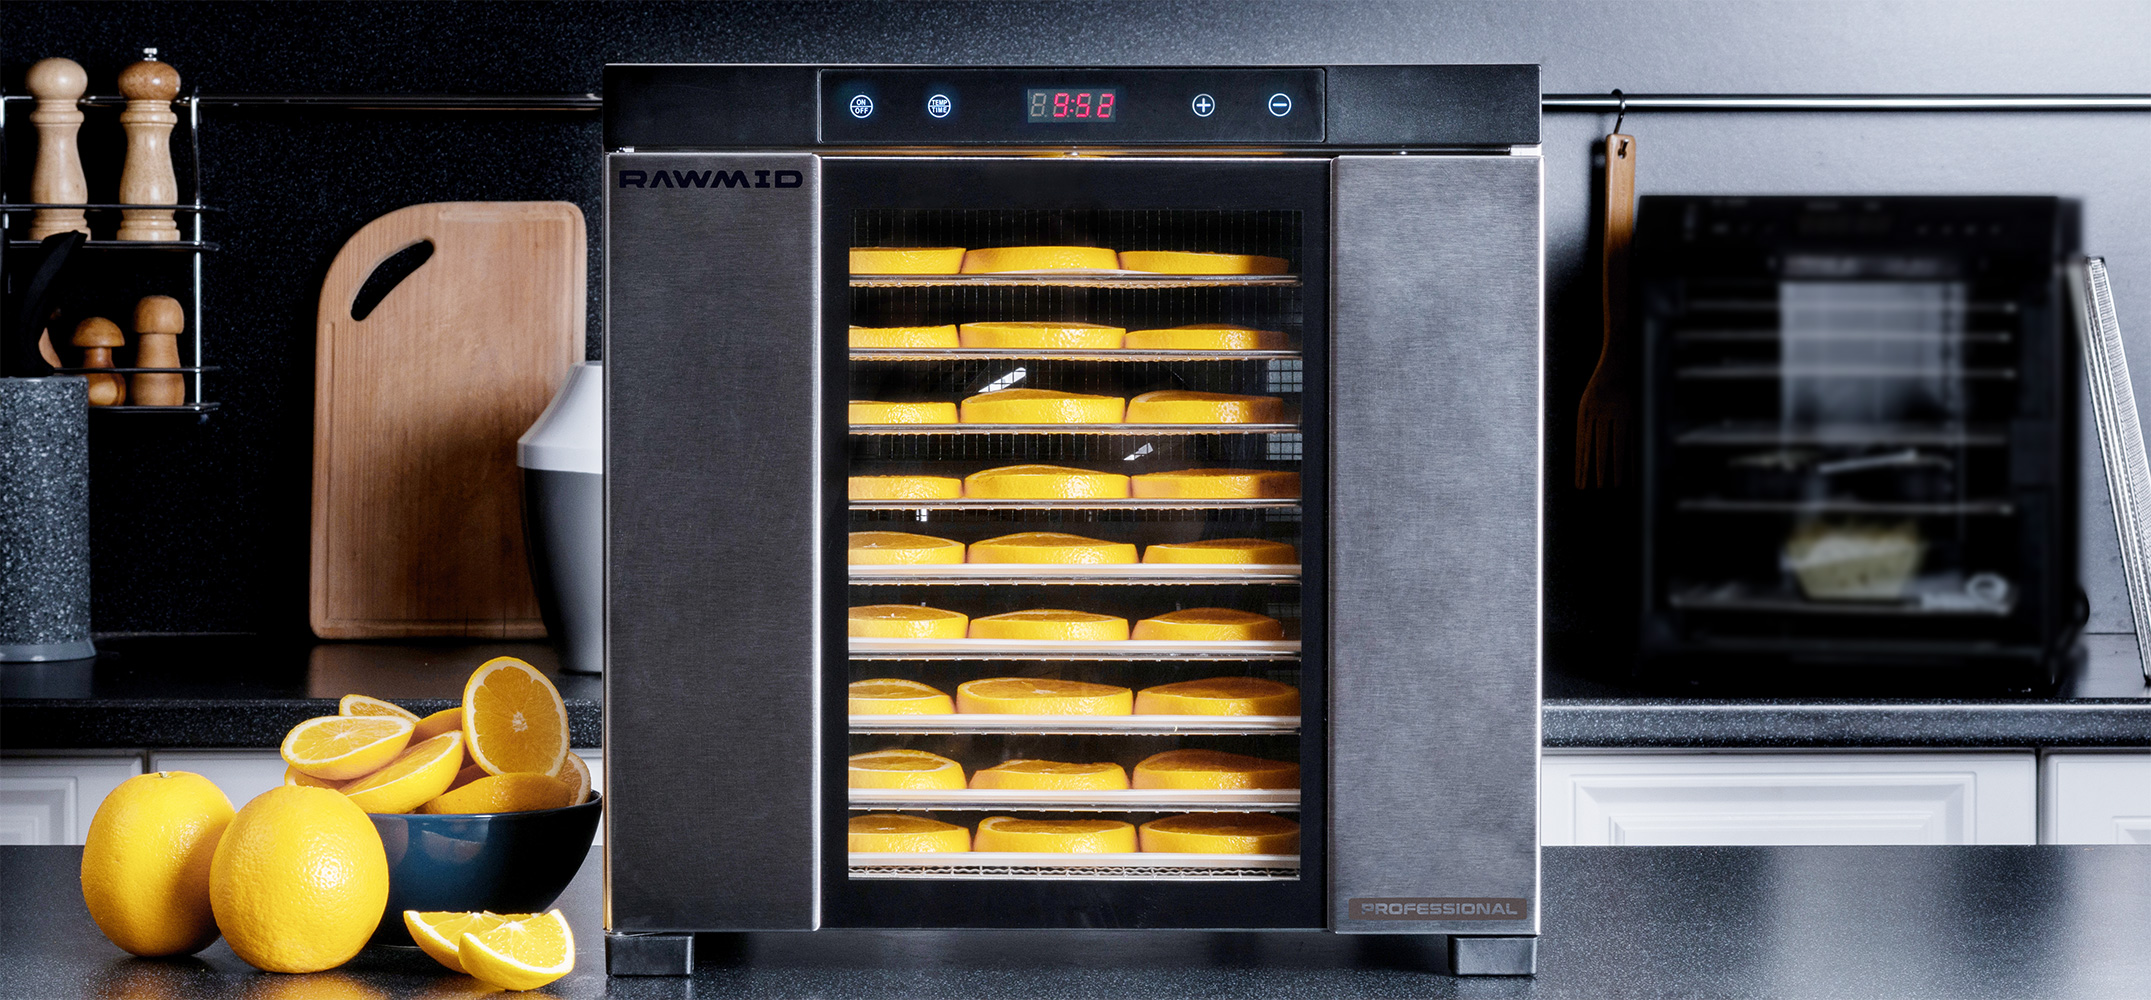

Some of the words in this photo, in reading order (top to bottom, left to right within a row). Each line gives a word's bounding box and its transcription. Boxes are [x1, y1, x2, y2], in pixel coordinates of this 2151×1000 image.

[1053, 92, 1115, 118] 9:52
[618, 170, 804, 188] RAWMID
[1361, 903, 1518, 915] PROFESSIONAL
